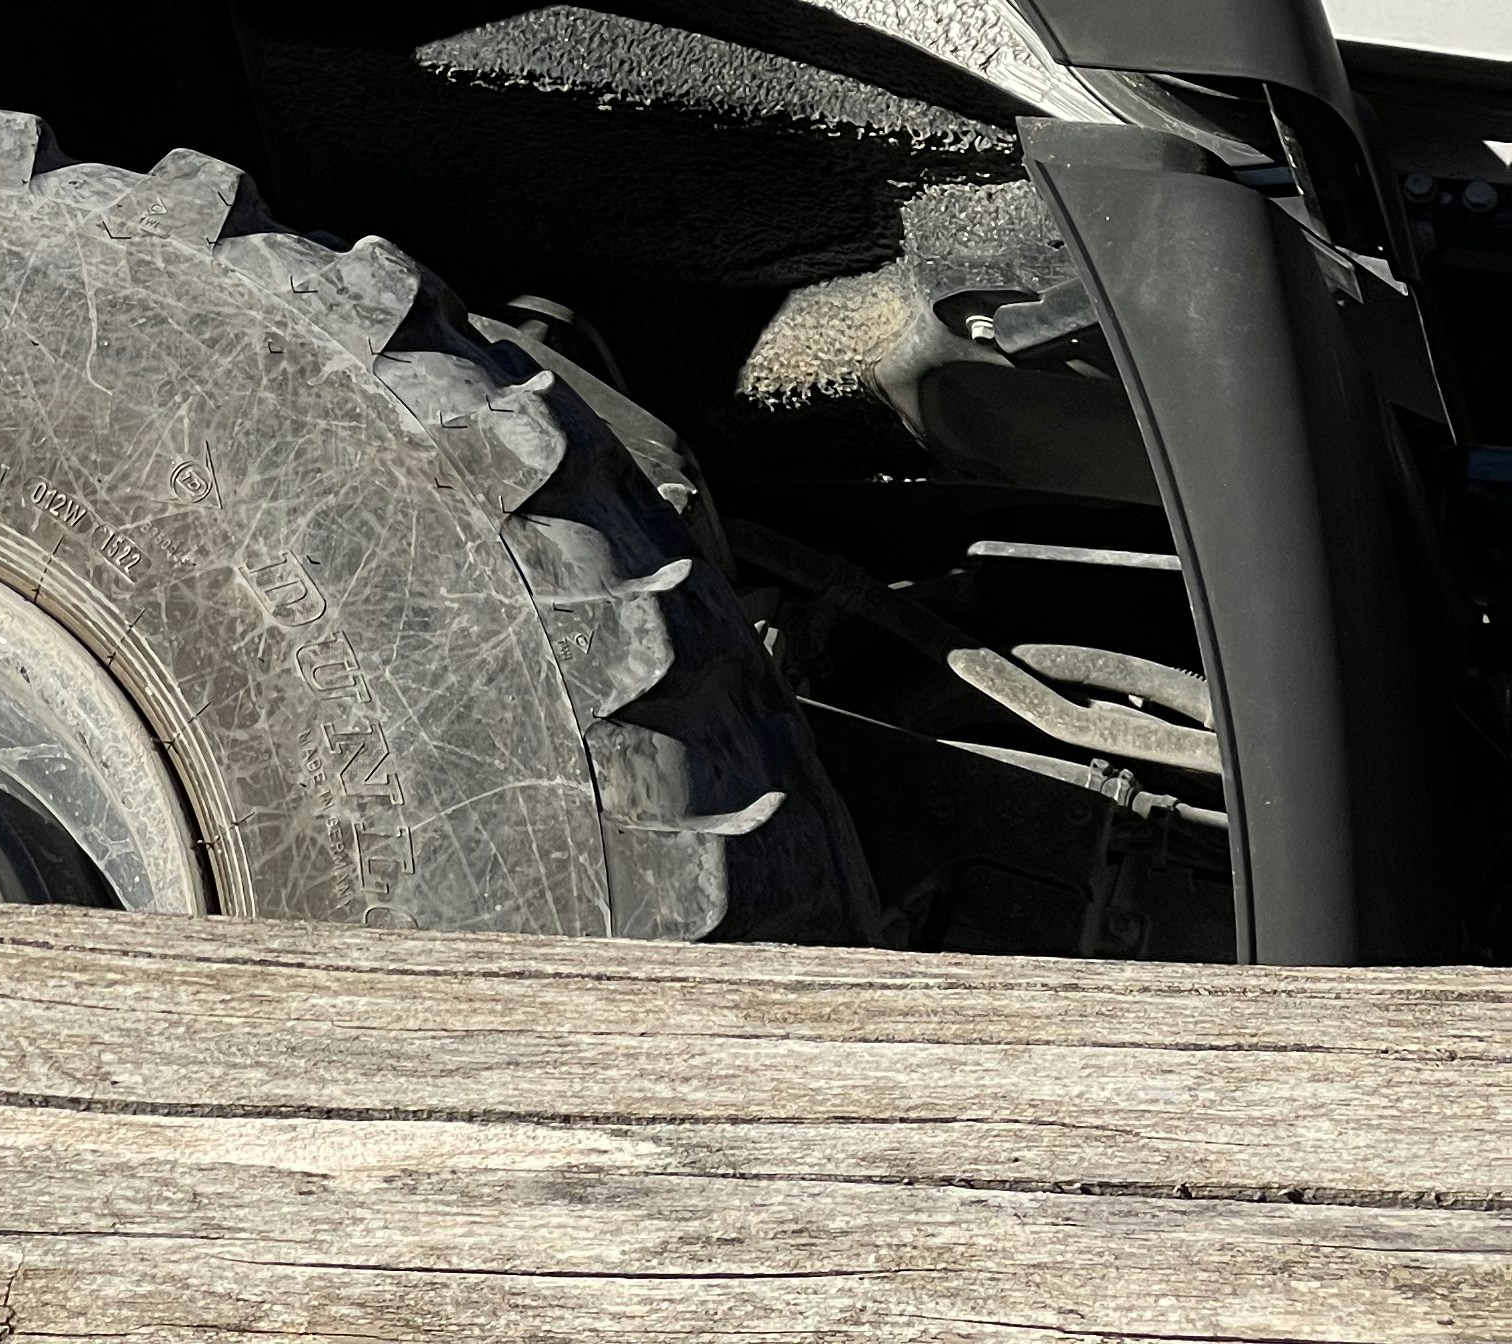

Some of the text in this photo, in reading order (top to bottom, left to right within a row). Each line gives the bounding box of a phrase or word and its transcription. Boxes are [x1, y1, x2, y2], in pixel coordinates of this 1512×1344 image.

[30, 481, 88, 528] 012W
[99, 526, 142, 576] 1522
[298, 728, 353, 913] MADE IN GERMANY
